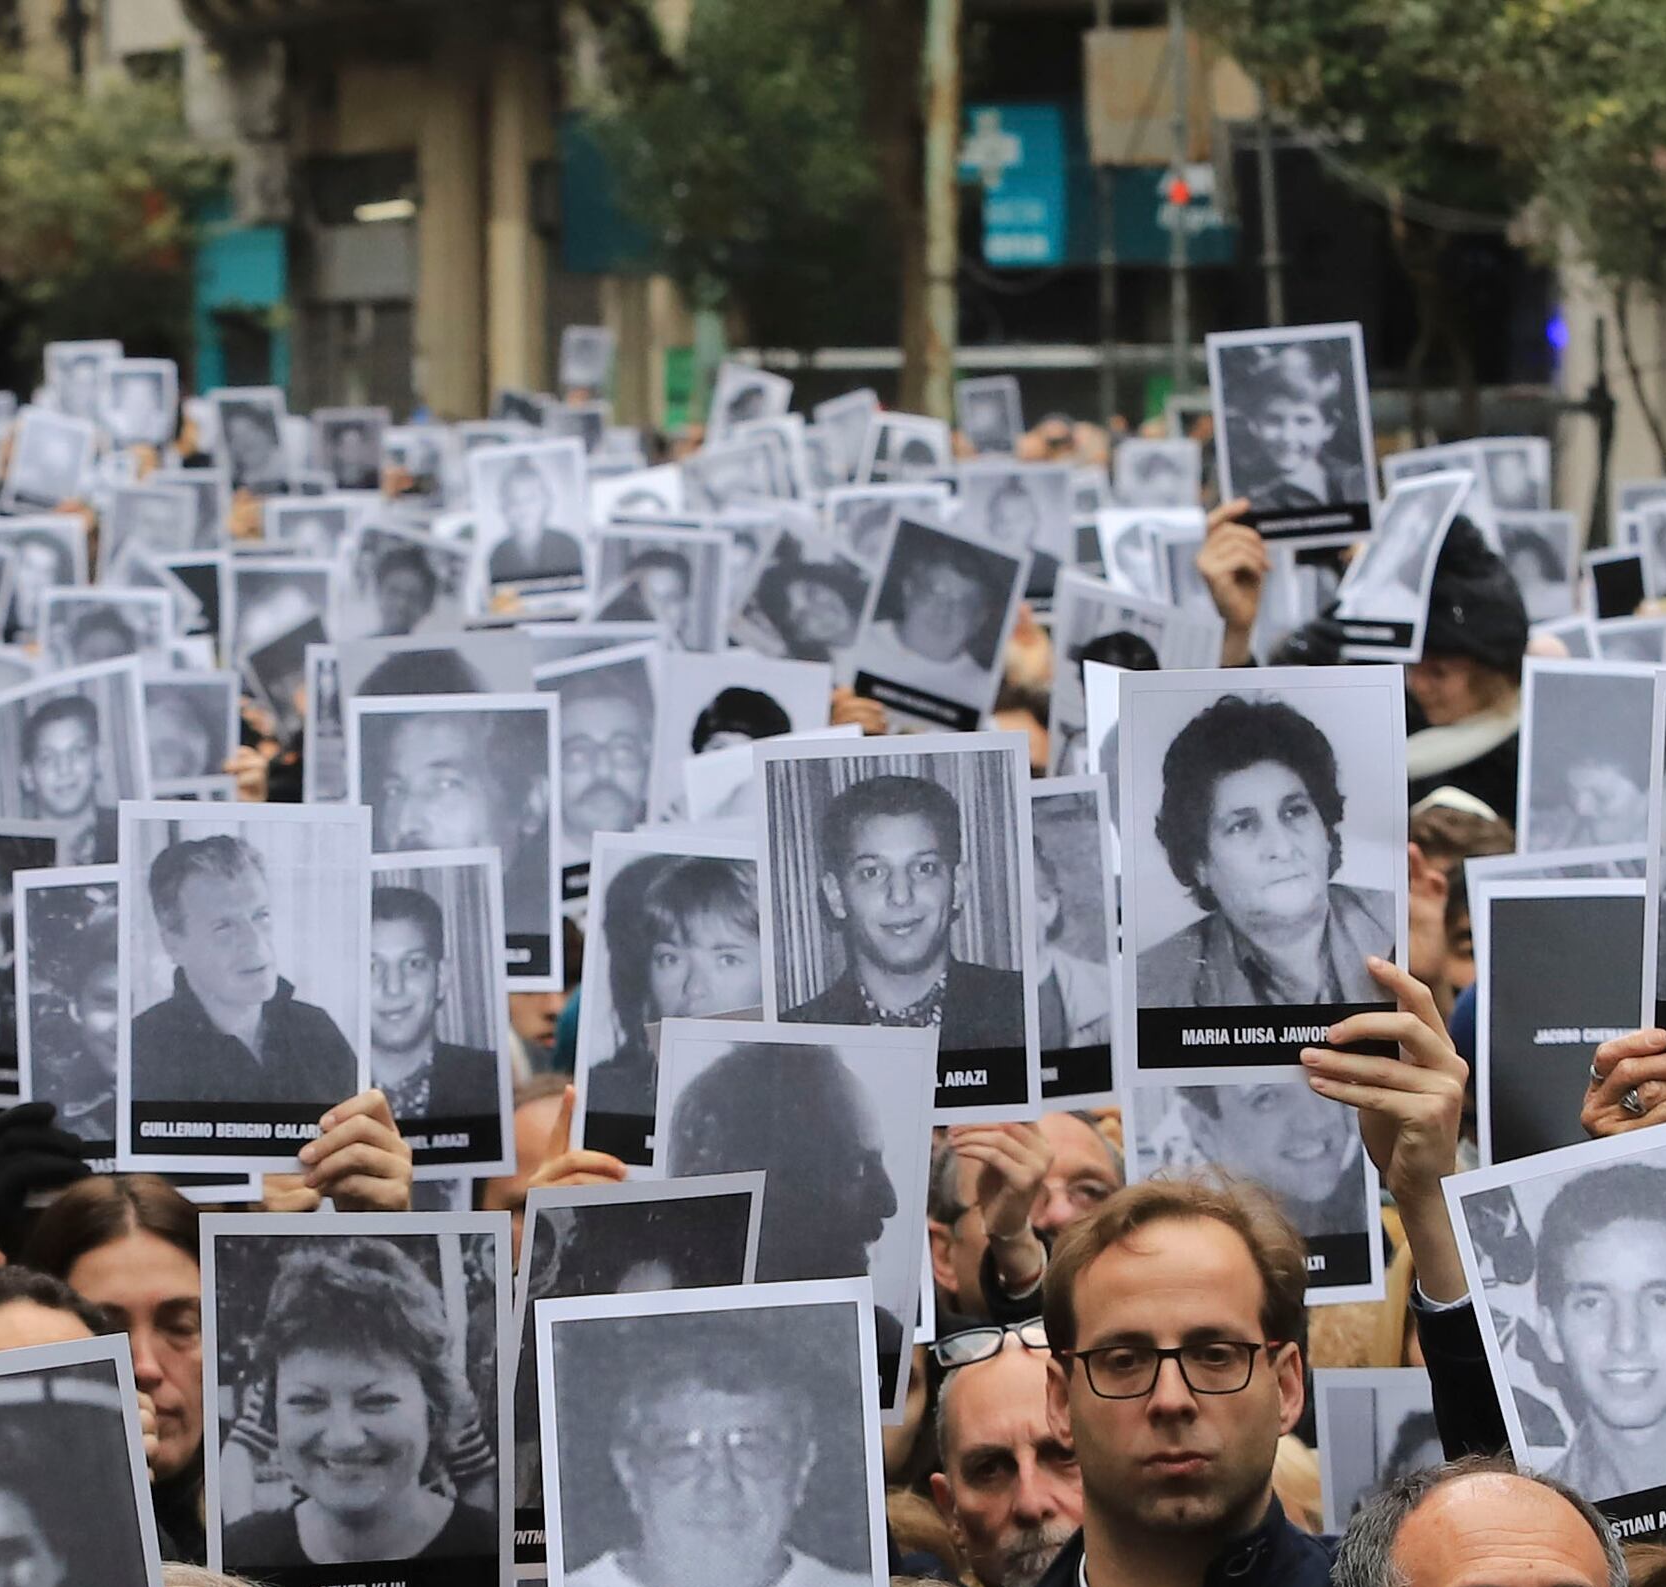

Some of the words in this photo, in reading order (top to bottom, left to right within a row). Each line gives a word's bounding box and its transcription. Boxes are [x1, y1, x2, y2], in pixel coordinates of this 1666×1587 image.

[1182, 1029, 1230, 1046] MARIA
[1234, 1028, 1276, 1045] LUISA
[1279, 1026, 1329, 1044] JAWOR
[945, 1070, 988, 1088] ARAZI
[140, 1121, 213, 1138] GUILLERMO
[215, 1122, 273, 1139] BENIGNO
[274, 1122, 323, 1139] GALAR
[1302, 1254, 1326, 1271] LTI
[1611, 1514, 1656, 1539] STIAN
